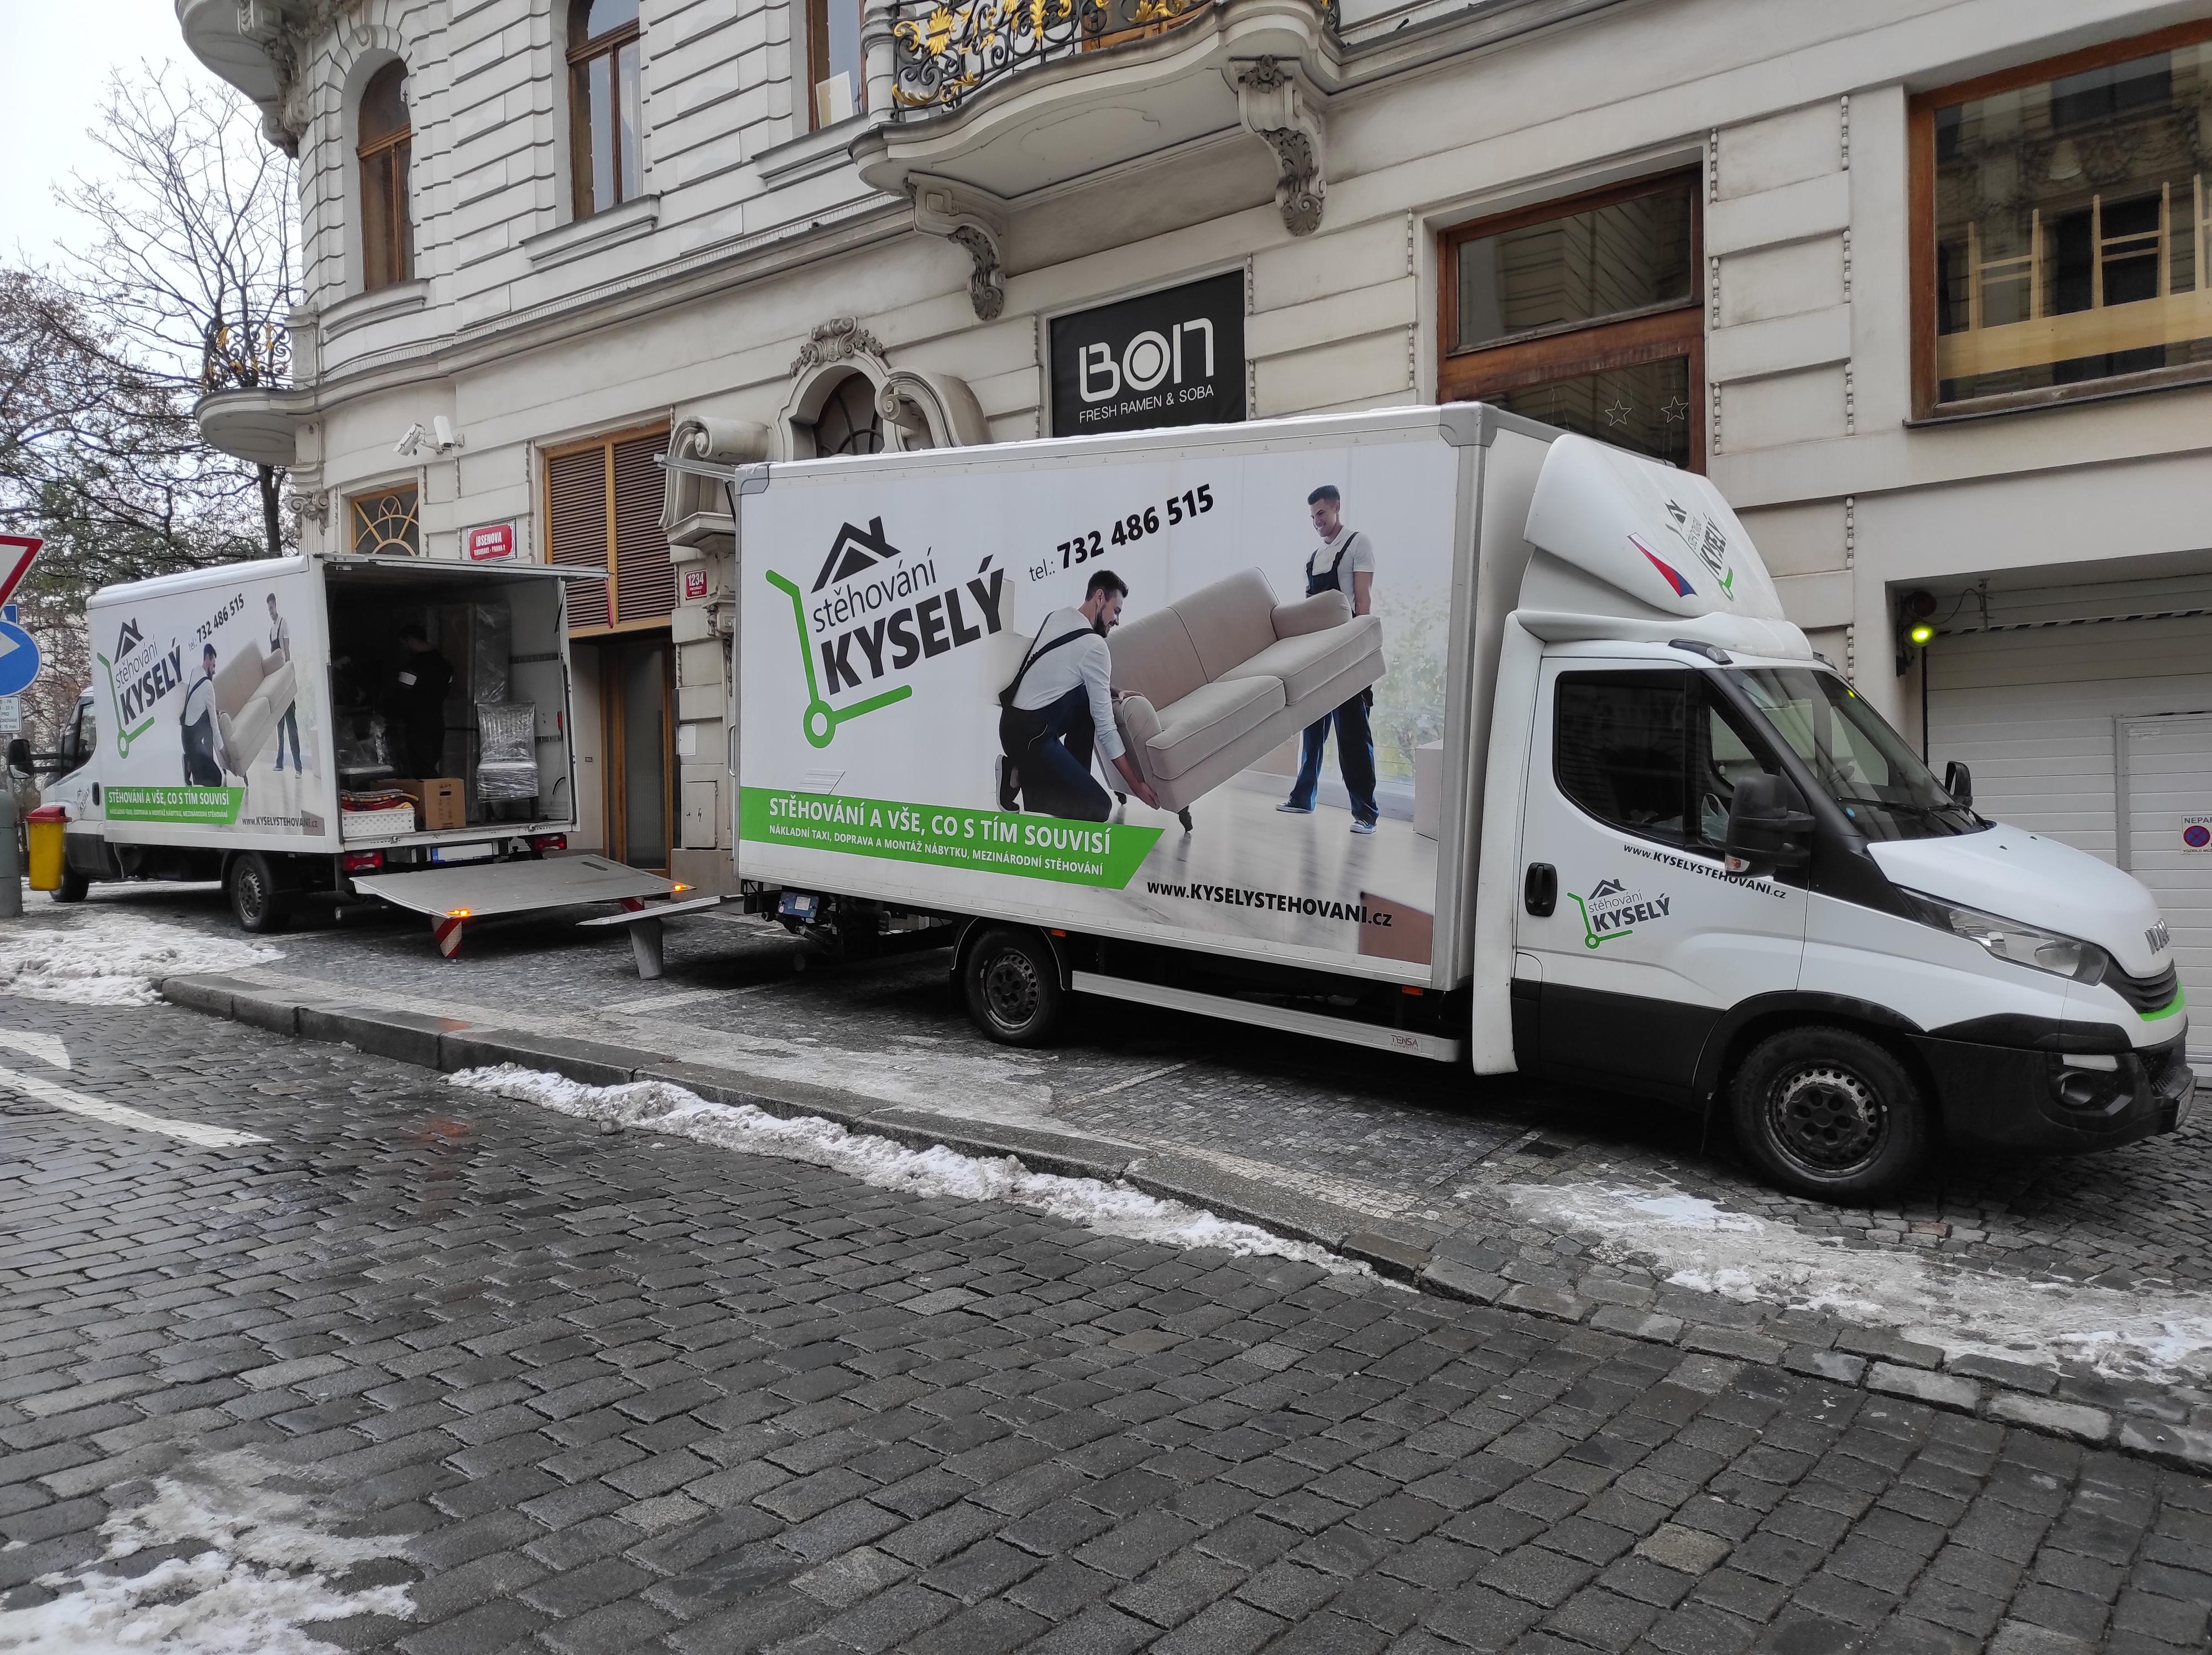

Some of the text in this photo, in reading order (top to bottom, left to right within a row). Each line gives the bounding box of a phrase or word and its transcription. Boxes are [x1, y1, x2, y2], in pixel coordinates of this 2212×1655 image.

[1079, 317, 1214, 403] BON
[1079, 384, 1214, 424] FRESH RAMEN & SOBA
[476, 531, 502, 547] IBSENOVA
[1029, 483, 1214, 582] tel.: 732 486 515
[687, 572, 704, 586] 1234
[813, 547, 937, 633] stěhování
[197, 620, 212, 643] 732
[214, 606, 228, 629] 486
[229, 593, 244, 617] 515
[820, 554, 1005, 696] KYSELÝ
[115, 633, 158, 688] stěhování
[119, 637, 182, 726] KYSELÝ
[108, 789, 229, 806] STĚHOVÁNÍ A VŠE, CO S TÍM SOUVISÍ
[242, 816, 318, 828] www.KYSELYSTEHOVANI.cz
[769, 794, 1112, 854] STĚHOVÁNÍ A VŠE, CO S TÍM SOUVISÍ
[769, 823, 1104, 876] NÁKLADNÍ TAXI, DOPRAVA A MONTÁŽ NÁBYTKU, MEZINÁRODNÍ STĚHOVÁNÍ
[1624, 844, 1787, 899] www.KYSELYSTEHOVANI.cz
[1147, 881, 1392, 927] www.KYSELYSTEHOVANI.cz
[1588, 889, 1642, 913] stěhování
[1592, 892, 1670, 932] KYSELÝ
[1391, 1035, 1418, 1047] TENSA
